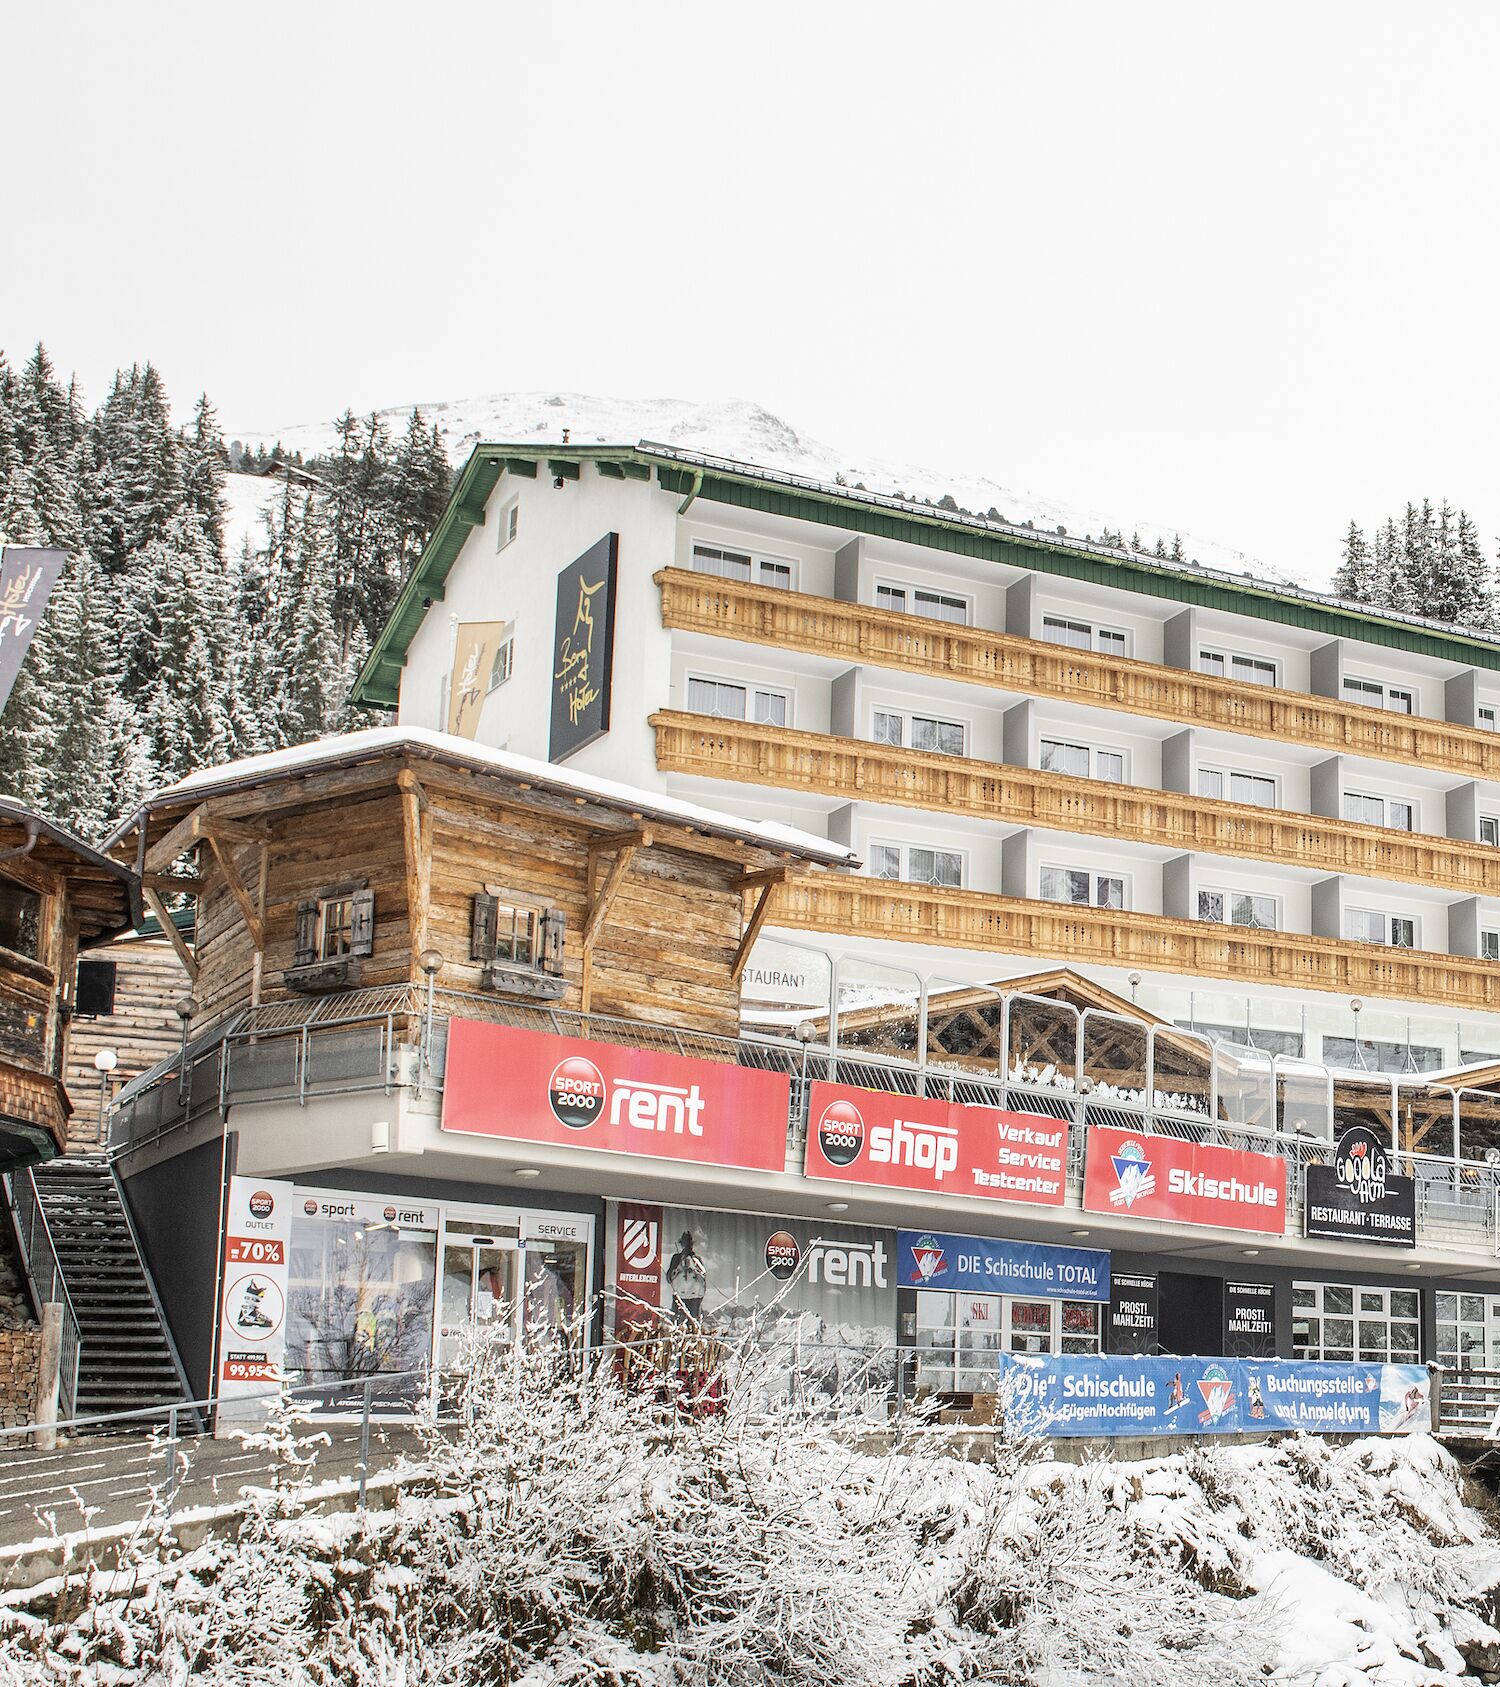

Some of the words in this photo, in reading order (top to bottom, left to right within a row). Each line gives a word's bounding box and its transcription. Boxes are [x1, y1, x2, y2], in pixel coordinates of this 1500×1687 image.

[741, 968, 805, 988] STAURANT
[555, 1077, 600, 1095] SPORT
[558, 1092, 596, 1109] 2000
[610, 1085, 705, 1136] rent
[823, 1119, 860, 1136] SPORT
[998, 1123, 1063, 1148] Verkauf
[825, 1133, 856, 1148] 2000
[869, 1120, 958, 1180] shop
[999, 1148, 1061, 1172] Service
[972, 1168, 1060, 1195] Testcenter
[1168, 1168, 1277, 1207] Skischule
[321, 1203, 355, 1218] sport
[398, 1210, 424, 1223] rent
[1311, 1206, 1366, 1226] RESTAURANT
[1370, 1213, 1412, 1231] TERRASSE
[245, 1220, 274, 1230] OUTLET
[538, 1224, 577, 1237] SERVICE
[767, 1245, 797, 1258] SPORT
[771, 1255, 794, 1267] 2000
[808, 1241, 888, 1288] rent
[957, 1254, 981, 1274] DIE
[985, 1256, 1054, 1281] Schischule
[1057, 1264, 1097, 1285] TOTAL
[971, 1302, 990, 1320] SKI
[1119, 1301, 1148, 1315] PROST!
[1235, 1307, 1265, 1321] PROST!
[1113, 1313, 1154, 1329] MAHLZEIT!
[1228, 1319, 1272, 1334] MAHLZEIT!
[1063, 1375, 1156, 1398] Schischule
[1267, 1374, 1363, 1398] Buchungsstelle
[1273, 1403, 1298, 1420] und
[1300, 1402, 1370, 1424] Anmeldung
